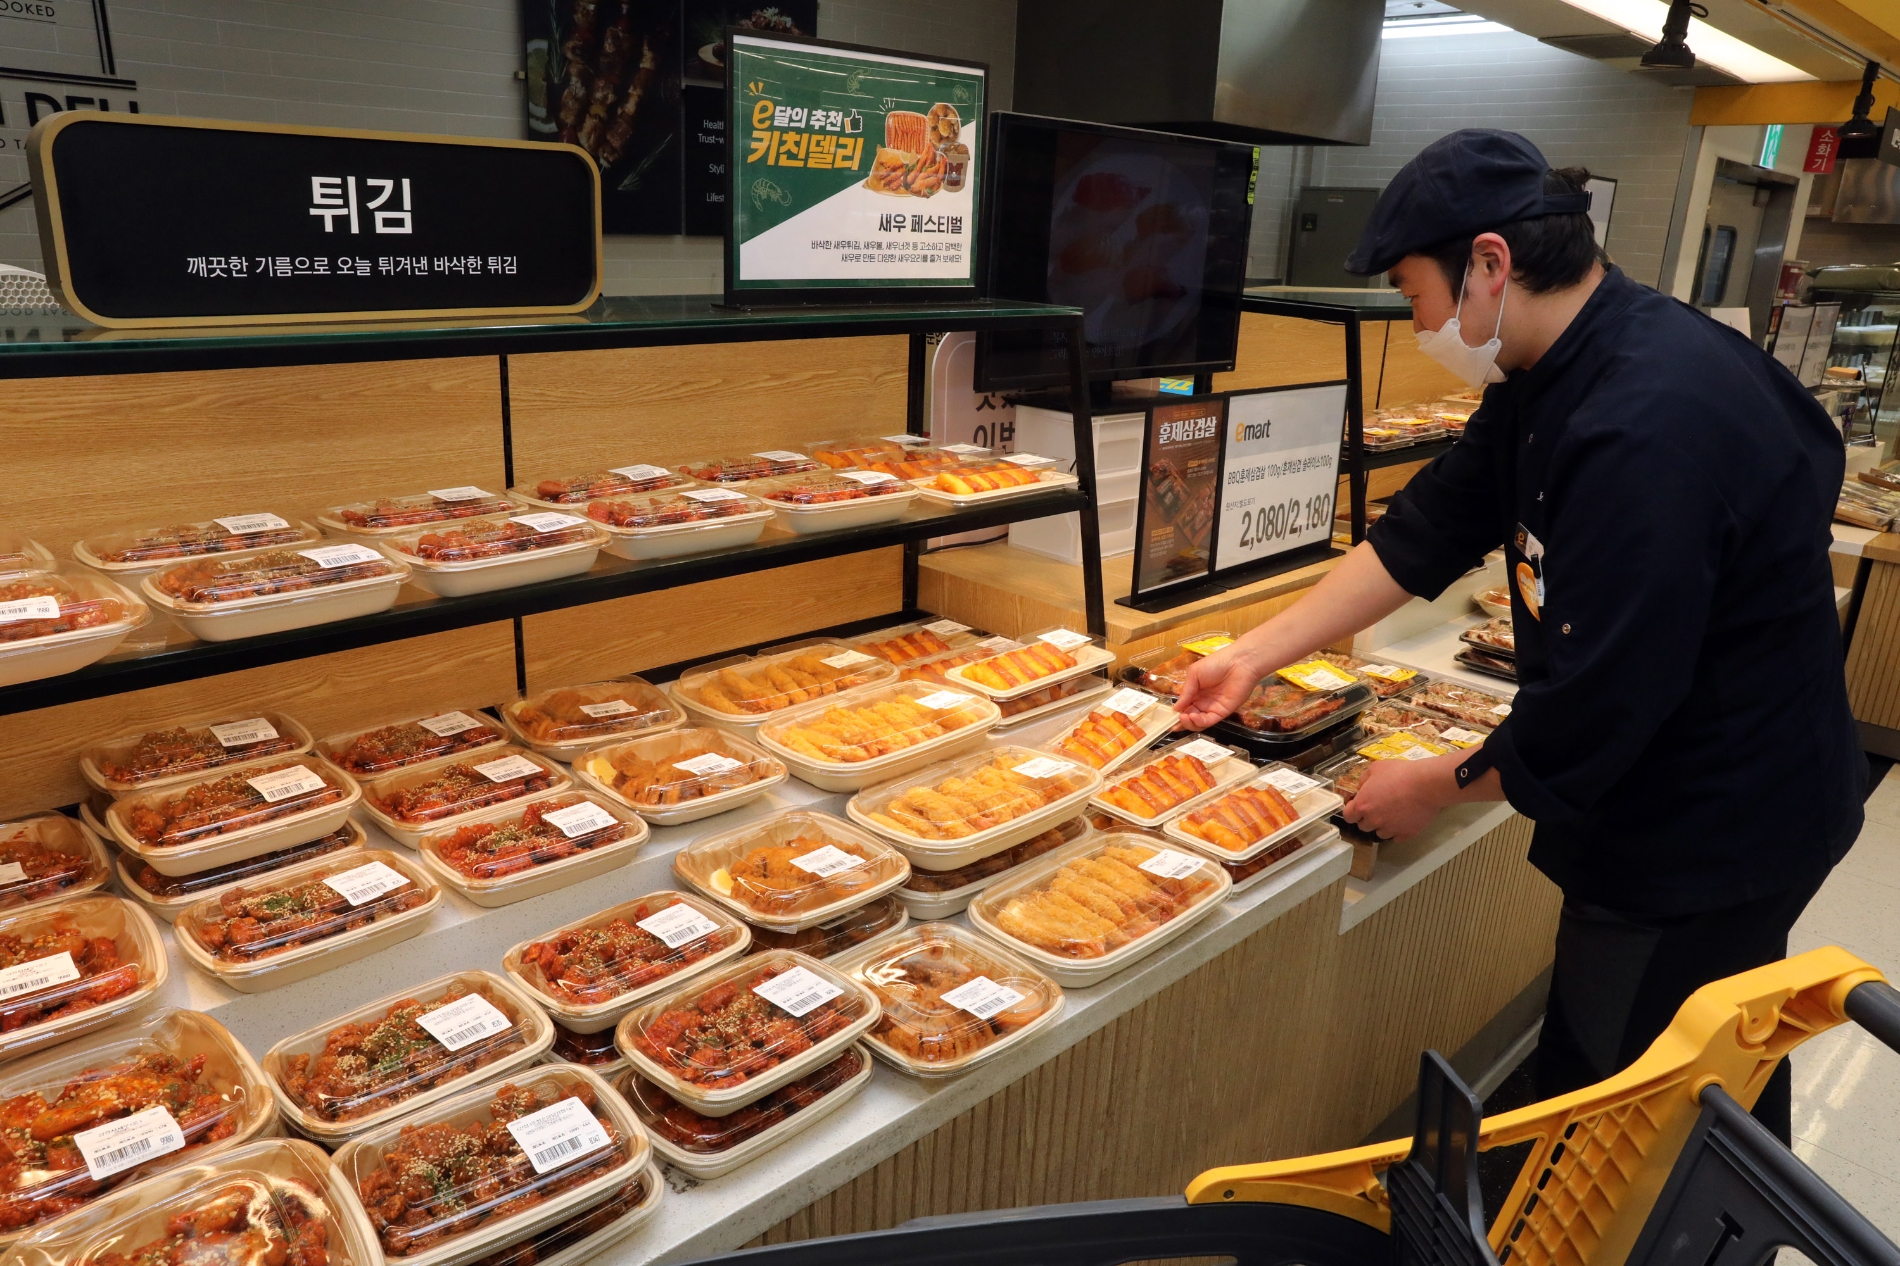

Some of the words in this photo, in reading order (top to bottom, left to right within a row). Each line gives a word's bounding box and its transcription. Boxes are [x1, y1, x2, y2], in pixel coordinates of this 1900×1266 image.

[809, 109, 844, 132] 추천
[747, 130, 865, 171] 키친델리
[1812, 130, 1834, 171] 소화기
[308, 176, 413, 234] 튀김
[878, 213, 907, 233] 새우
[910, 214, 963, 235] 페스티벌
[811, 240, 832, 250] 바삭한
[919, 241, 944, 251] 고소하고
[944, 242, 963, 252] 담백한
[841, 253, 862, 263] 새우로
[862, 253, 876, 263] 만든
[877, 253, 897, 263] 다양한
[897, 253, 929, 263] 새우요리를
[929, 254, 942, 263] 즐겨
[186, 256, 249, 278] 깨끗한
[255, 256, 331, 277] 기름으로
[336, 256, 372, 276] 오늘
[377, 256, 429, 276] 튀겨낸
[433, 256, 483, 275] 바삭한
[487, 255, 518, 275] 튀김
[1158, 416, 1217, 445] 훈제삼겹살
[1235, 419, 1272, 443] emart
[1239, 492, 1331, 551] 2,080/2,180
